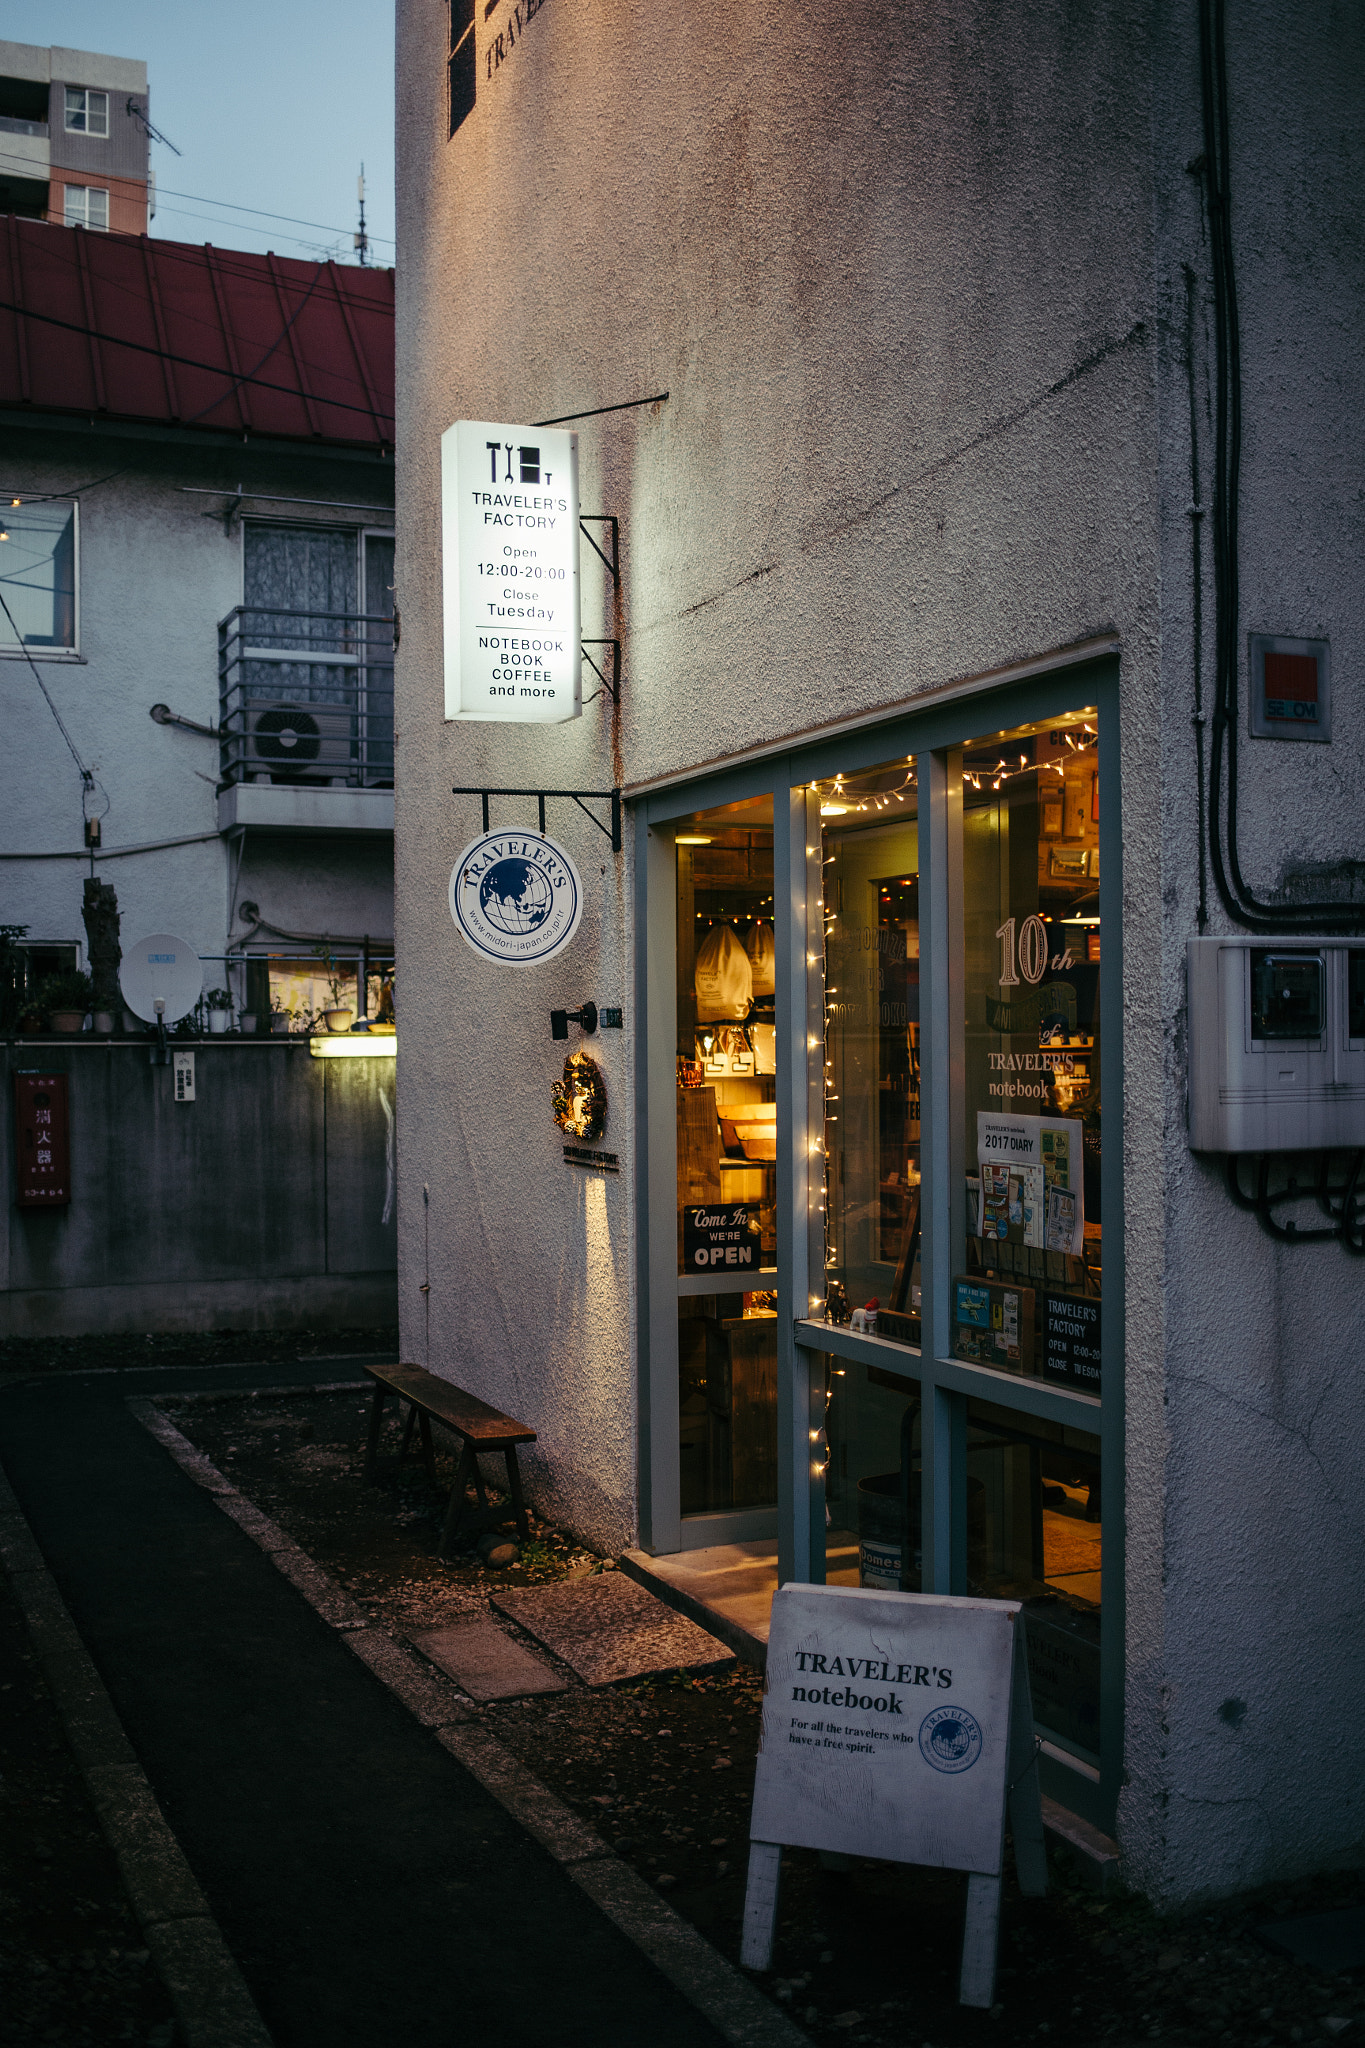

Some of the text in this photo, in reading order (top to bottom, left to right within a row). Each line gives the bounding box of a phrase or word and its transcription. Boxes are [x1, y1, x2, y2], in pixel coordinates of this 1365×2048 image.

[472, 492, 567, 512] TRAVELER'S
[484, 513, 556, 529] FACTORY
[503, 546, 537, 559] Open
[477, 563, 566, 580] 12:00-20:00
[503, 589, 539, 601] Close
[487, 603, 555, 621] Tuesday
[479, 637, 564, 652] NOTEBOOK
[500, 654, 543, 667] BOOK
[492, 669, 552, 682] COFFEE
[489, 684, 556, 698] and more
[1267, 700, 1316, 718] SECOM
[464, 841, 567, 889] TRAVELER'S
[469, 909, 565, 951] www.midori-japan.co.jp/tr
[1041, 1024, 1060, 1045] of
[988, 1052, 1074, 1072] TRAVELER'S
[989, 1079, 1049, 1099] notebook
[36, 1109, 52, 1165] 消火器
[985, 1134, 1034, 1153] 2017 DIARY
[694, 1208, 748, 1228] Come In
[709, 1231, 741, 1241] WE'RE
[694, 1246, 752, 1266] OPEN
[1048, 1299, 1097, 1322] TRAVELER'S
[1048, 1318, 1087, 1339] FACTORY
[1048, 1339, 1101, 1360] OPEN 12:00-20
[1048, 1357, 1068, 1371] CLOSE
[795, 1651, 953, 1690] TRAVELER'S
[792, 1685, 903, 1715] notebook
[790, 1718, 914, 1744] For all the travelers who
[925, 1710, 978, 1741] TRAVELER'S
[788, 1733, 876, 1754] have a free spirit.
